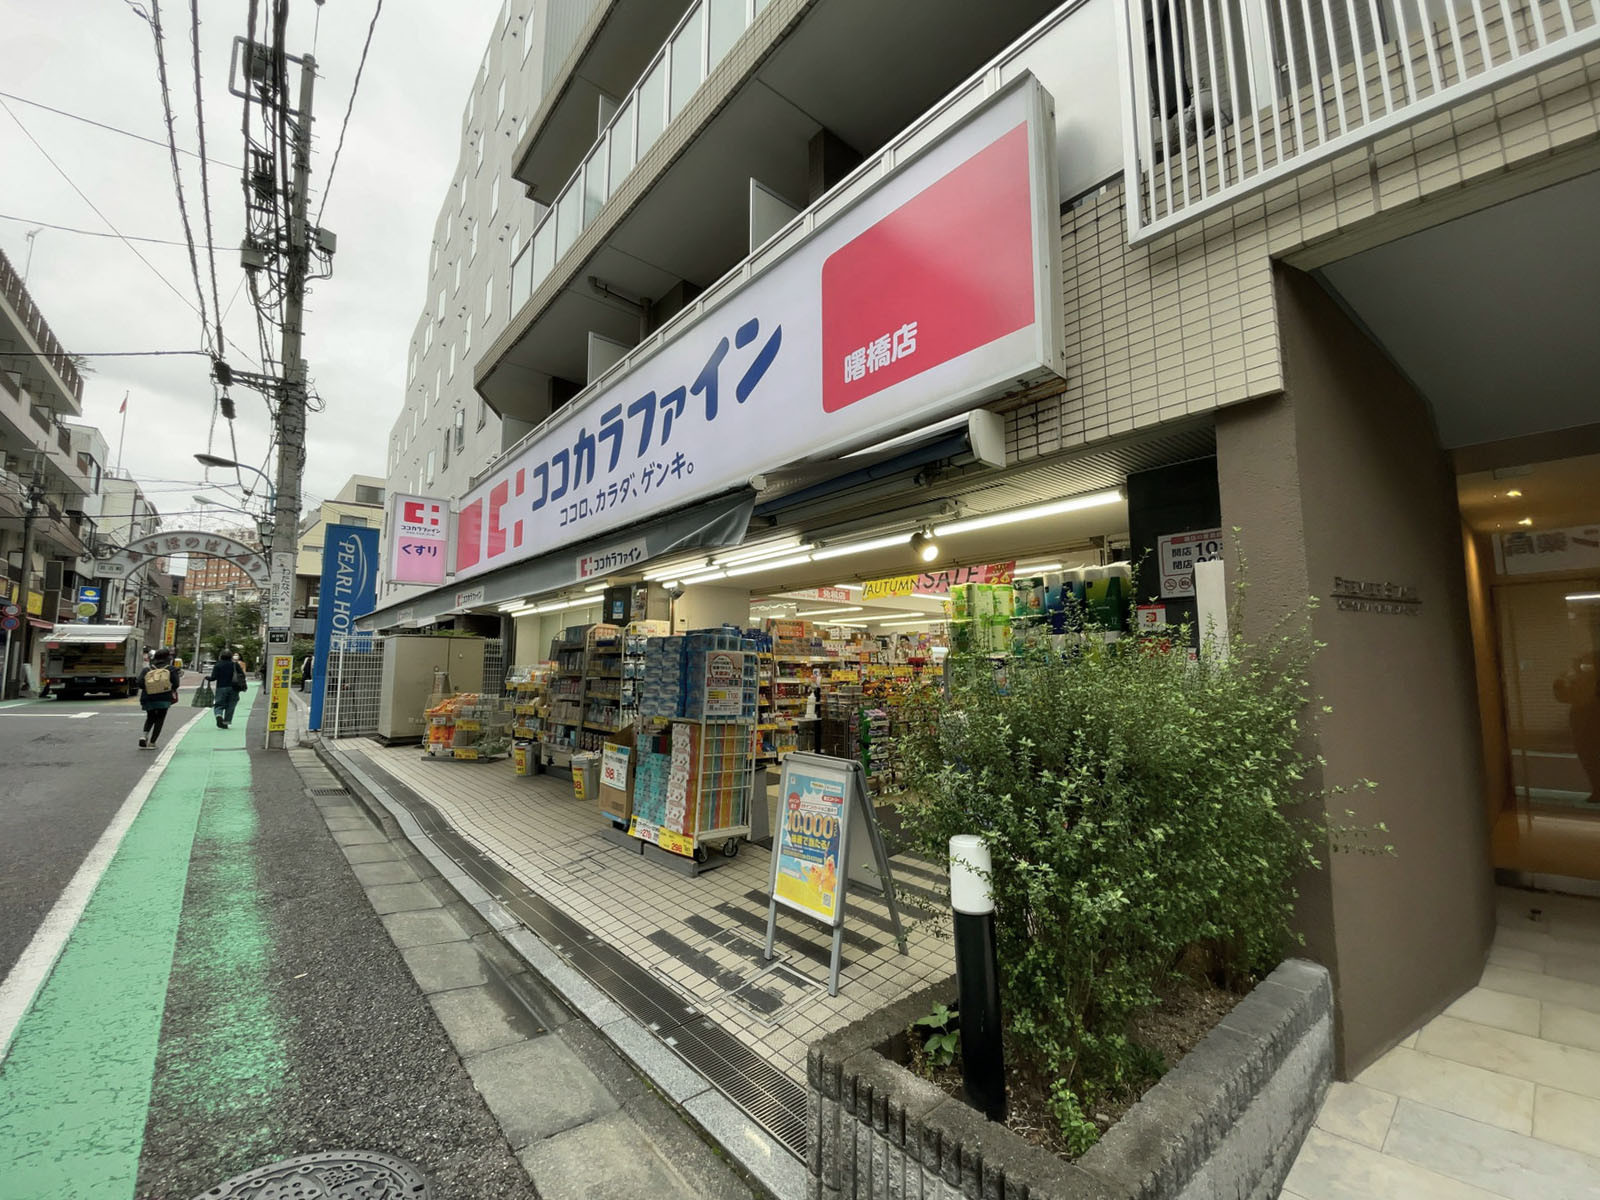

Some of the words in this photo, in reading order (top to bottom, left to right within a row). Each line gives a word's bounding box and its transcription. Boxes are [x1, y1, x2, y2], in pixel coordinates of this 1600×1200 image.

[844, 321, 918, 384] 曙橋店
[532, 317, 782, 512] ココカラファイン
[560, 451, 694, 527] ココロ、カラダ、ゲンキ。
[401, 525, 441, 534] ココカラファイン
[402, 544, 437, 557] くすり
[594, 547, 642, 571] ココカラファイン
[1171, 546, 1192, 558] 開店
[334, 541, 356, 597] PEARL
[1172, 559, 1193, 570] 閉店
[866, 576, 920, 594] AUTUMN
[922, 565, 979, 590] SALE
